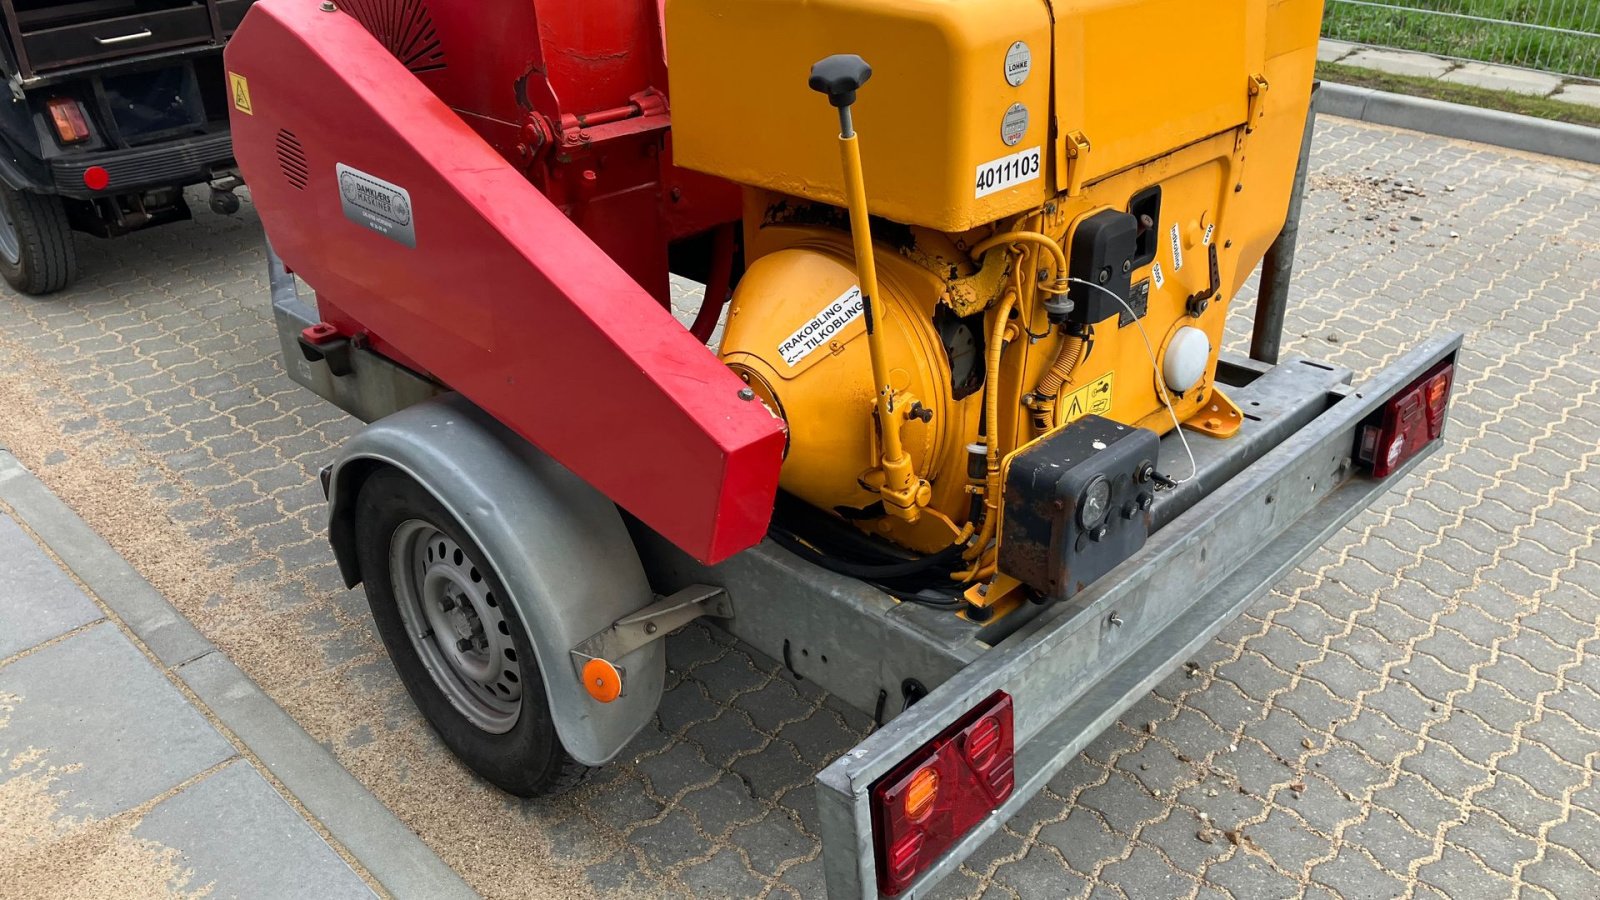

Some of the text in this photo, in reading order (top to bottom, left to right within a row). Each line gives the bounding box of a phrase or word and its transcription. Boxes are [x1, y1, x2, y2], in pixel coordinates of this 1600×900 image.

[976, 153, 1039, 190] 4011103
[357, 193, 392, 213] MASKINER
[1153, 263, 1163, 283] Stop
[778, 303, 842, 356] FRAKOBLING
[803, 301, 864, 350] TILKOBLING
